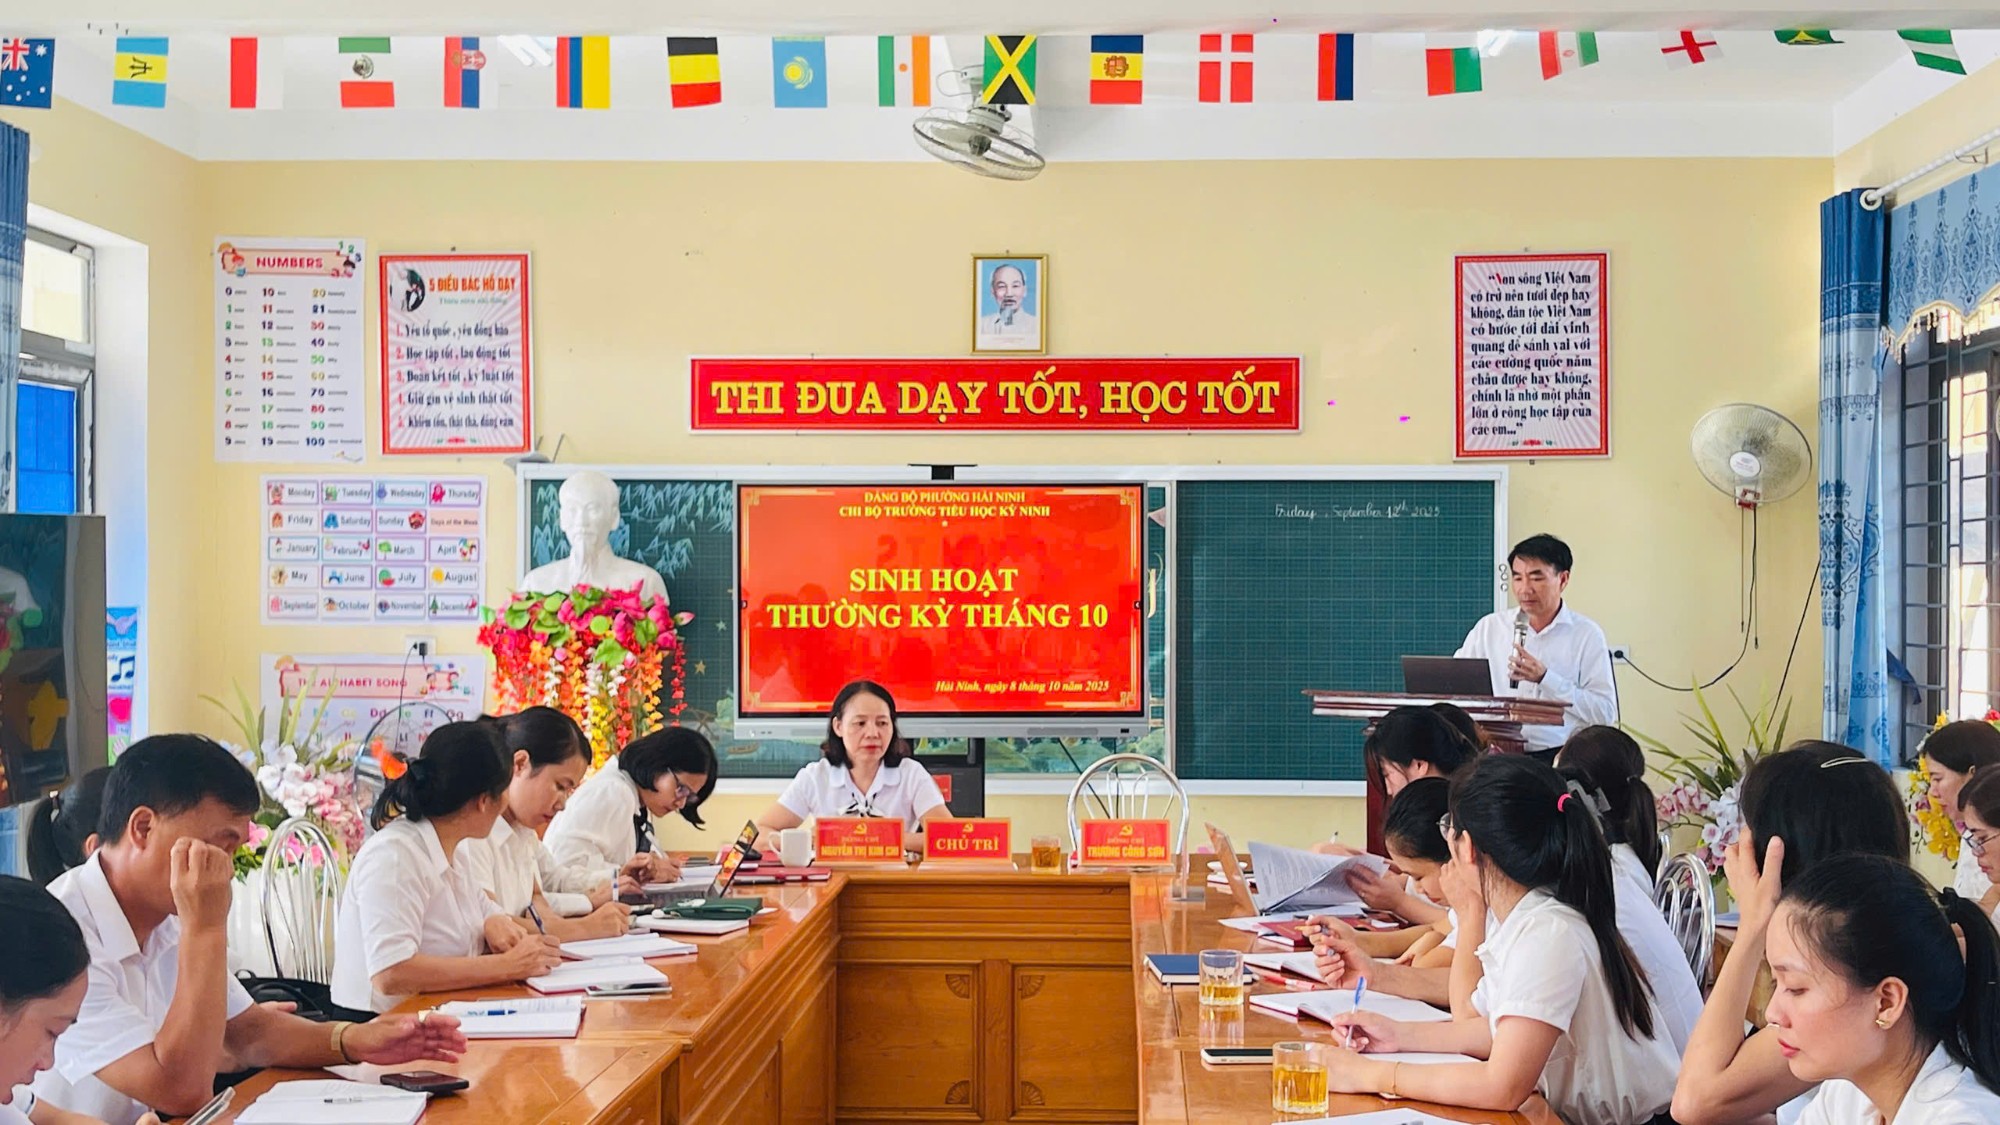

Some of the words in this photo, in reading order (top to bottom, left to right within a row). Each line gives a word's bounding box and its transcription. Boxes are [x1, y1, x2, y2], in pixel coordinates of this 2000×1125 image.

[256, 257, 323, 269] NUMBERS
[429, 279, 435, 291] 5
[461, 275, 480, 291] BÁC
[483, 273, 495, 291] HỒ
[499, 278, 515, 293] DẠY
[1518, 273, 1541, 287] sông
[1545, 272, 1565, 287] Việt
[1569, 272, 1590, 284] Nam
[225, 286, 232, 297] 0
[263, 287, 275, 297] 10
[312, 288, 326, 298] 20
[1471, 290, 1482, 302] có
[1505, 291, 1523, 301] nên
[1527, 290, 1547, 301] tươi
[1572, 289, 1590, 303] hay
[227, 304, 232, 314] 1
[263, 304, 272, 314] 11
[312, 304, 325, 314] 21
[1471, 307, 1504, 319] không,
[1508, 306, 1525, 318] dân
[1548, 304, 1566, 320] Việt
[1570, 305, 1591, 317] Nam
[225, 320, 232, 330] 2
[262, 320, 273, 330] 12
[311, 320, 324, 331] 30
[1472, 324, 1484, 335] có
[1564, 322, 1589, 334] vinh
[225, 337, 232, 347] 3
[262, 337, 273, 347] 13
[311, 337, 325, 347] 40
[1472, 341, 1504, 355] quang
[1524, 339, 1549, 351] sánh
[1554, 339, 1569, 353] vai
[1574, 338, 1590, 350] với
[225, 354, 232, 364] 4
[262, 354, 273, 364] 14
[311, 354, 325, 364] 50
[1472, 356, 1491, 369] các
[225, 371, 232, 381] 5
[261, 371, 274, 381] 15
[311, 371, 325, 381] 60
[1472, 373, 1498, 385] châu
[1531, 373, 1550, 387] hay
[225, 387, 232, 397] 6
[262, 387, 274, 397] 16
[311, 388, 325, 397] 70
[711, 381, 784, 414] THI
[796, 381, 886, 414] ĐUA
[898, 381, 987, 423] DẠY
[999, 365, 1088, 420] TỐT,
[1099, 382, 1187, 422] HỌC
[1198, 366, 1279, 414] TỐT
[225, 404, 232, 414] 7
[262, 404, 274, 414] 17
[311, 404, 325, 414] 80
[225, 420, 232, 430] 8
[262, 420, 274, 430] 18
[311, 420, 325, 430] 90
[225, 436, 232, 446] 9
[262, 436, 274, 446] 19
[306, 436, 325, 446] 100
[288, 488, 315, 499] Monday
[342, 488, 371, 499] Tuesday
[390, 489, 425, 499] Wednesday
[448, 489, 479, 500] Thursday
[864, 490, 899, 503] ĐẢNG
[901, 490, 918, 504] BỘ
[920, 489, 970, 503] PHƯỜNG
[972, 490, 993, 503] HẢI
[995, 491, 1025, 503] NINH
[839, 506, 862, 517] CHI
[865, 505, 882, 519] BỘ
[884, 503, 936, 517] TRƯỜNG
[970, 506, 997, 519] HỌC
[1019, 505, 1050, 517] NINH
[288, 515, 313, 526] Friday
[341, 516, 371, 527] Saturday
[378, 515, 404, 526] Sunday
[287, 544, 316, 555] January
[333, 546, 362, 557] February
[394, 546, 415, 554] March
[437, 545, 457, 556] April
[291, 571, 308, 582] May
[344, 572, 365, 582] June
[398, 571, 416, 583] July
[444, 571, 477, 584] August
[850, 568, 922, 592] SINH
[931, 568, 1018, 598] HOẠT
[338, 601, 369, 610] October
[767, 598, 900, 628] THƯỜNG
[910, 598, 956, 627] KỲ
[961, 598, 1071, 628] THÁNG
[1080, 604, 1108, 628] 10
[376, 678, 408, 687] SONG
[1048, 681, 1061, 692] 10
[1085, 681, 1110, 692] 2025
[936, 834, 969, 850] CHỦ
[972, 836, 999, 850] TRÌ
